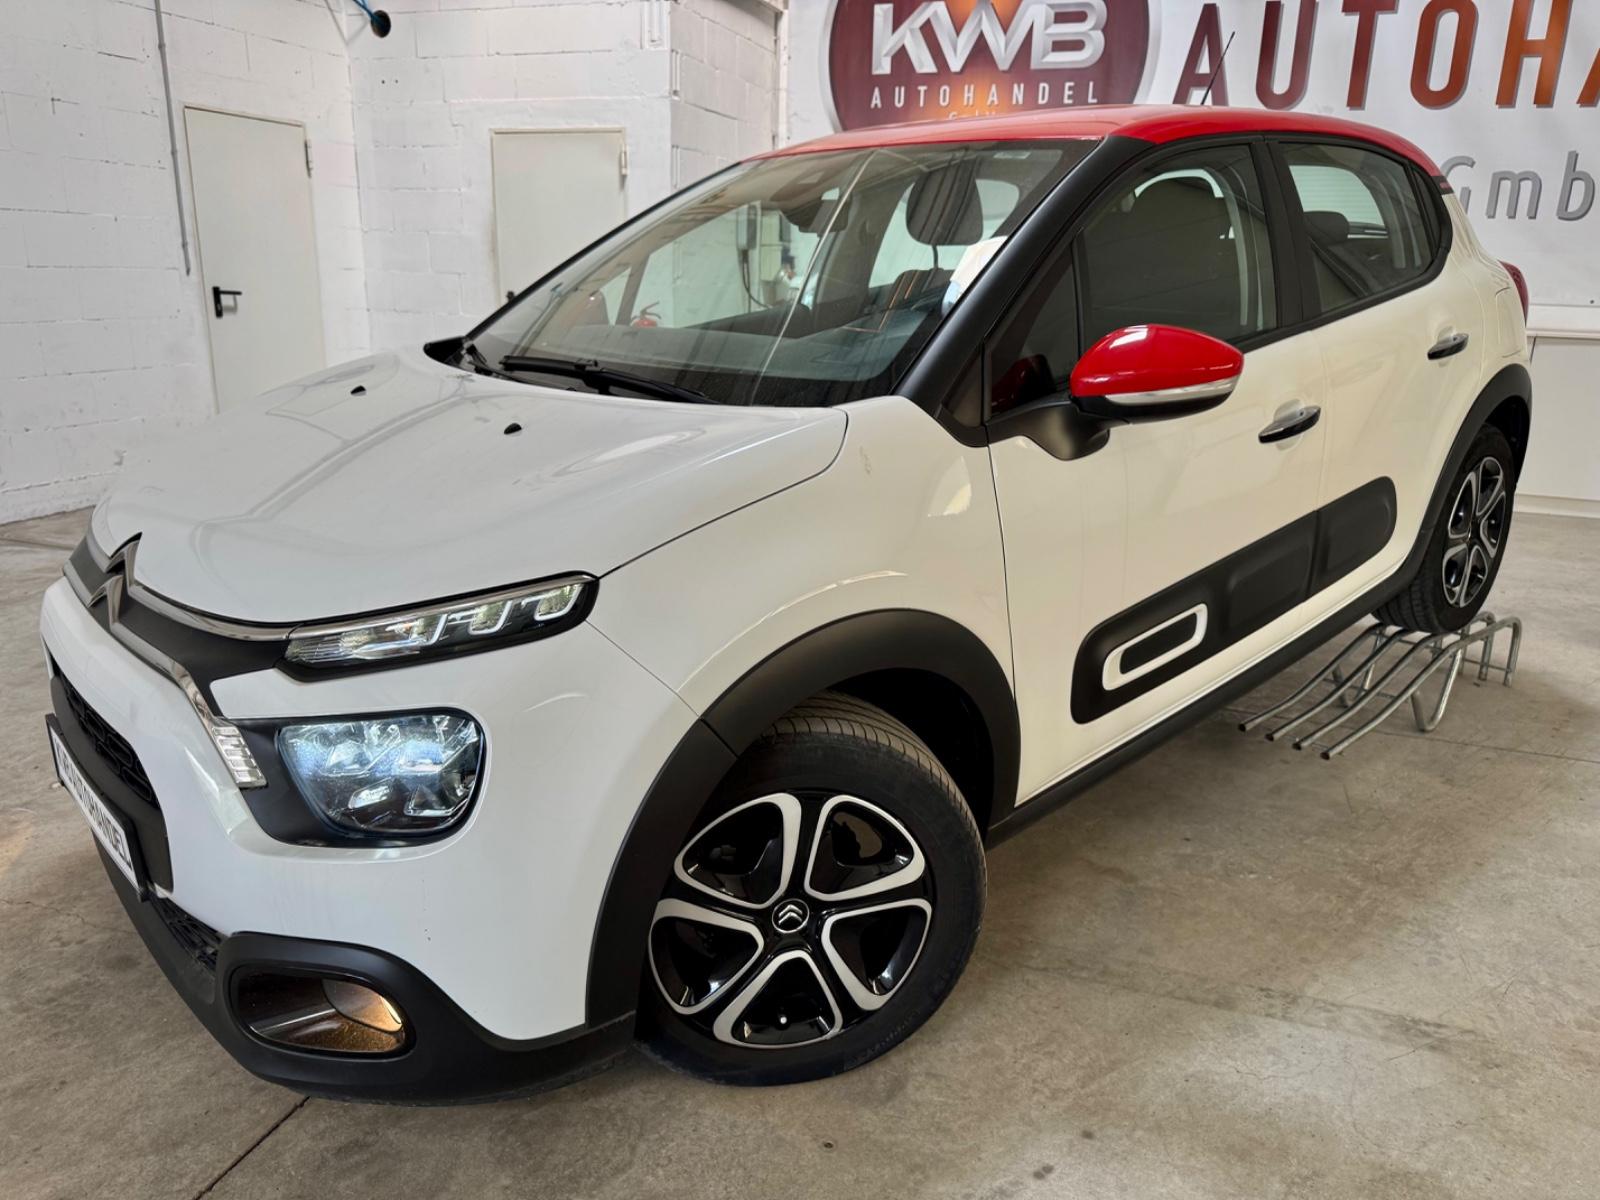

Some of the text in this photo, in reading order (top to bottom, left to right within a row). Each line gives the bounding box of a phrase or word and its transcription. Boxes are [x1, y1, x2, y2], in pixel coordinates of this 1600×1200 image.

[871, 0, 1107, 75] KWB
[1171, 0, 1600, 111] AUTOH
[870, 81, 1098, 109] AUTOHANDEL
